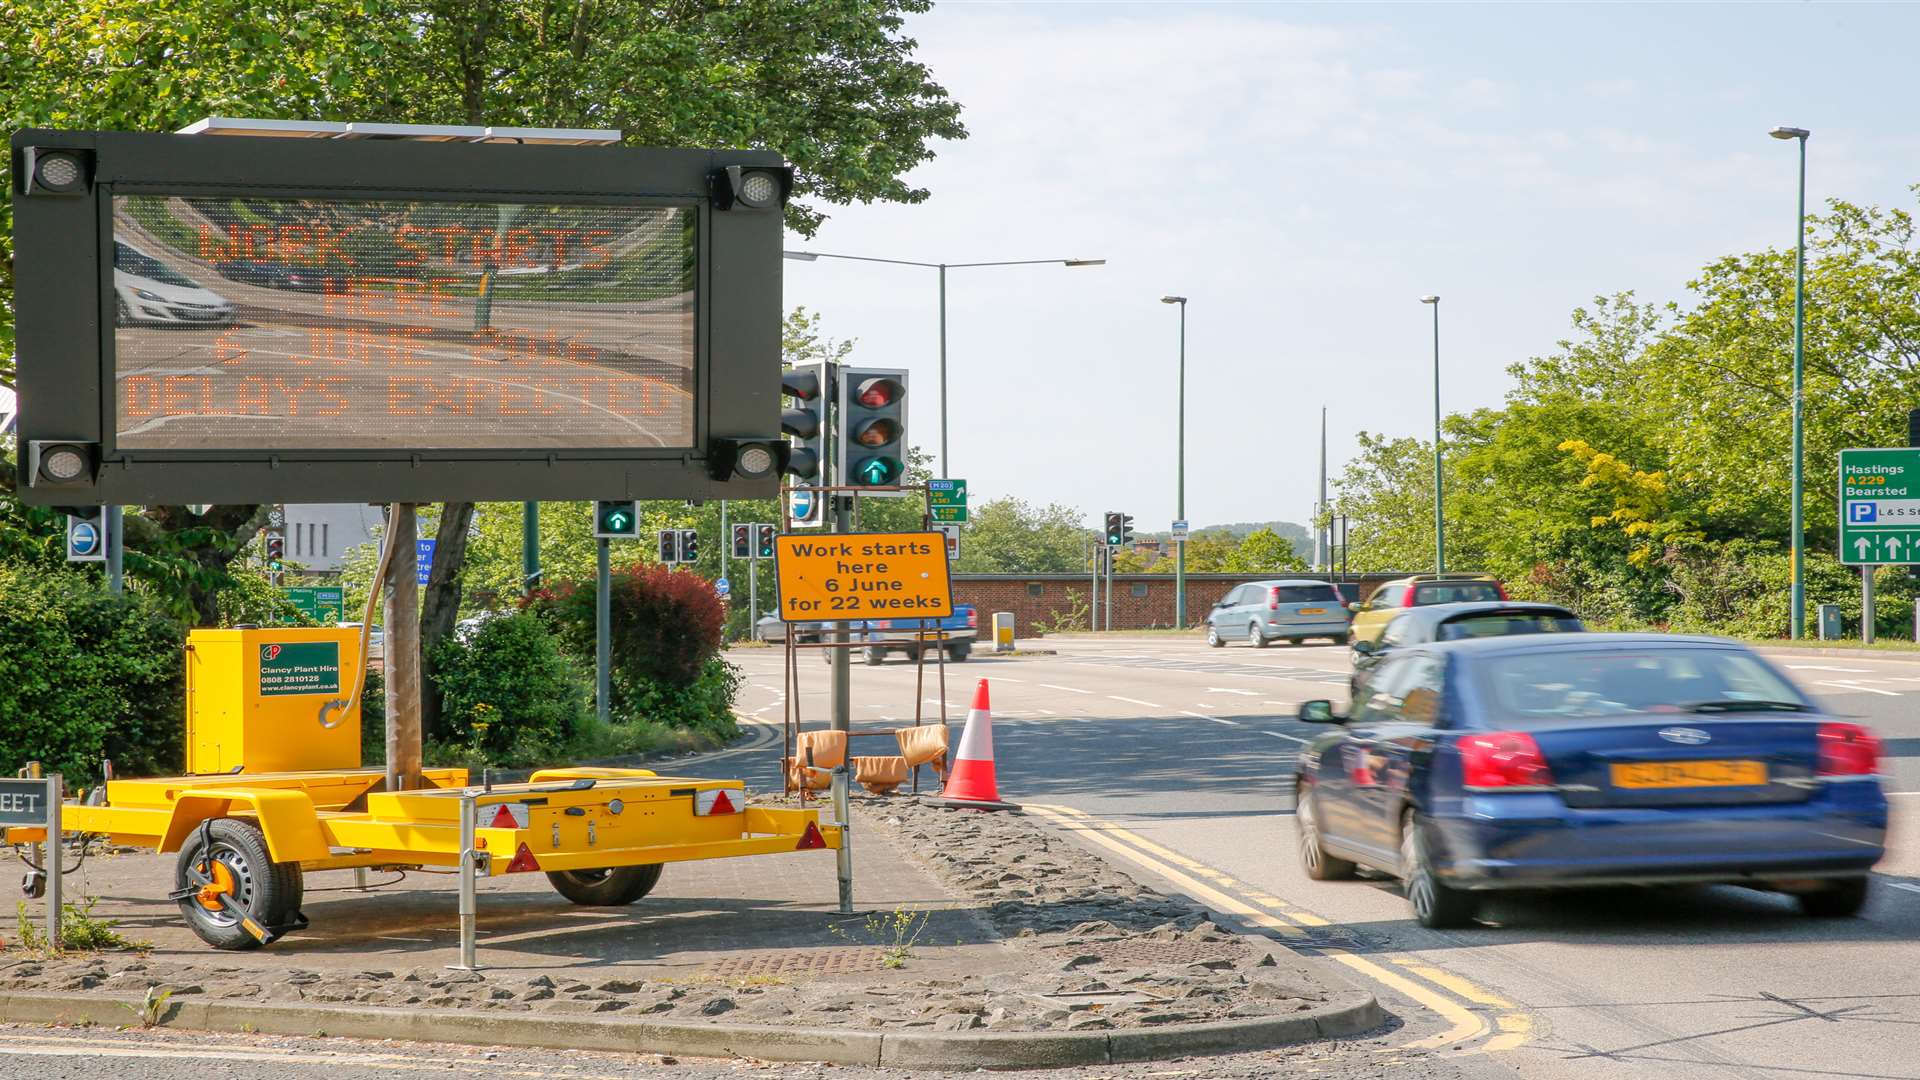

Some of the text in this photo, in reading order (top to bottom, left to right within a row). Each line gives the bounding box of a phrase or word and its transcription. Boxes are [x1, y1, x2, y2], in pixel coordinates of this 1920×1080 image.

[200, 224, 612, 269] WORK STARTS
[325, 277, 463, 316] HERE
[216, 326, 598, 366] 6 JUNE 2016
[127, 376, 671, 416] DELAYS EXPECTED
[1845, 464, 1905, 475] Hastings
[1845, 486, 1907, 497] Bearsted
[420, 543, 431, 551] to
[791, 543, 853, 557] Work
[861, 541, 931, 556] starts
[837, 561, 888, 574] here
[825, 579, 903, 592] 6 June
[789, 595, 942, 611] for 22 weeks
[260, 664, 338, 675] Clancy Plant Hire
